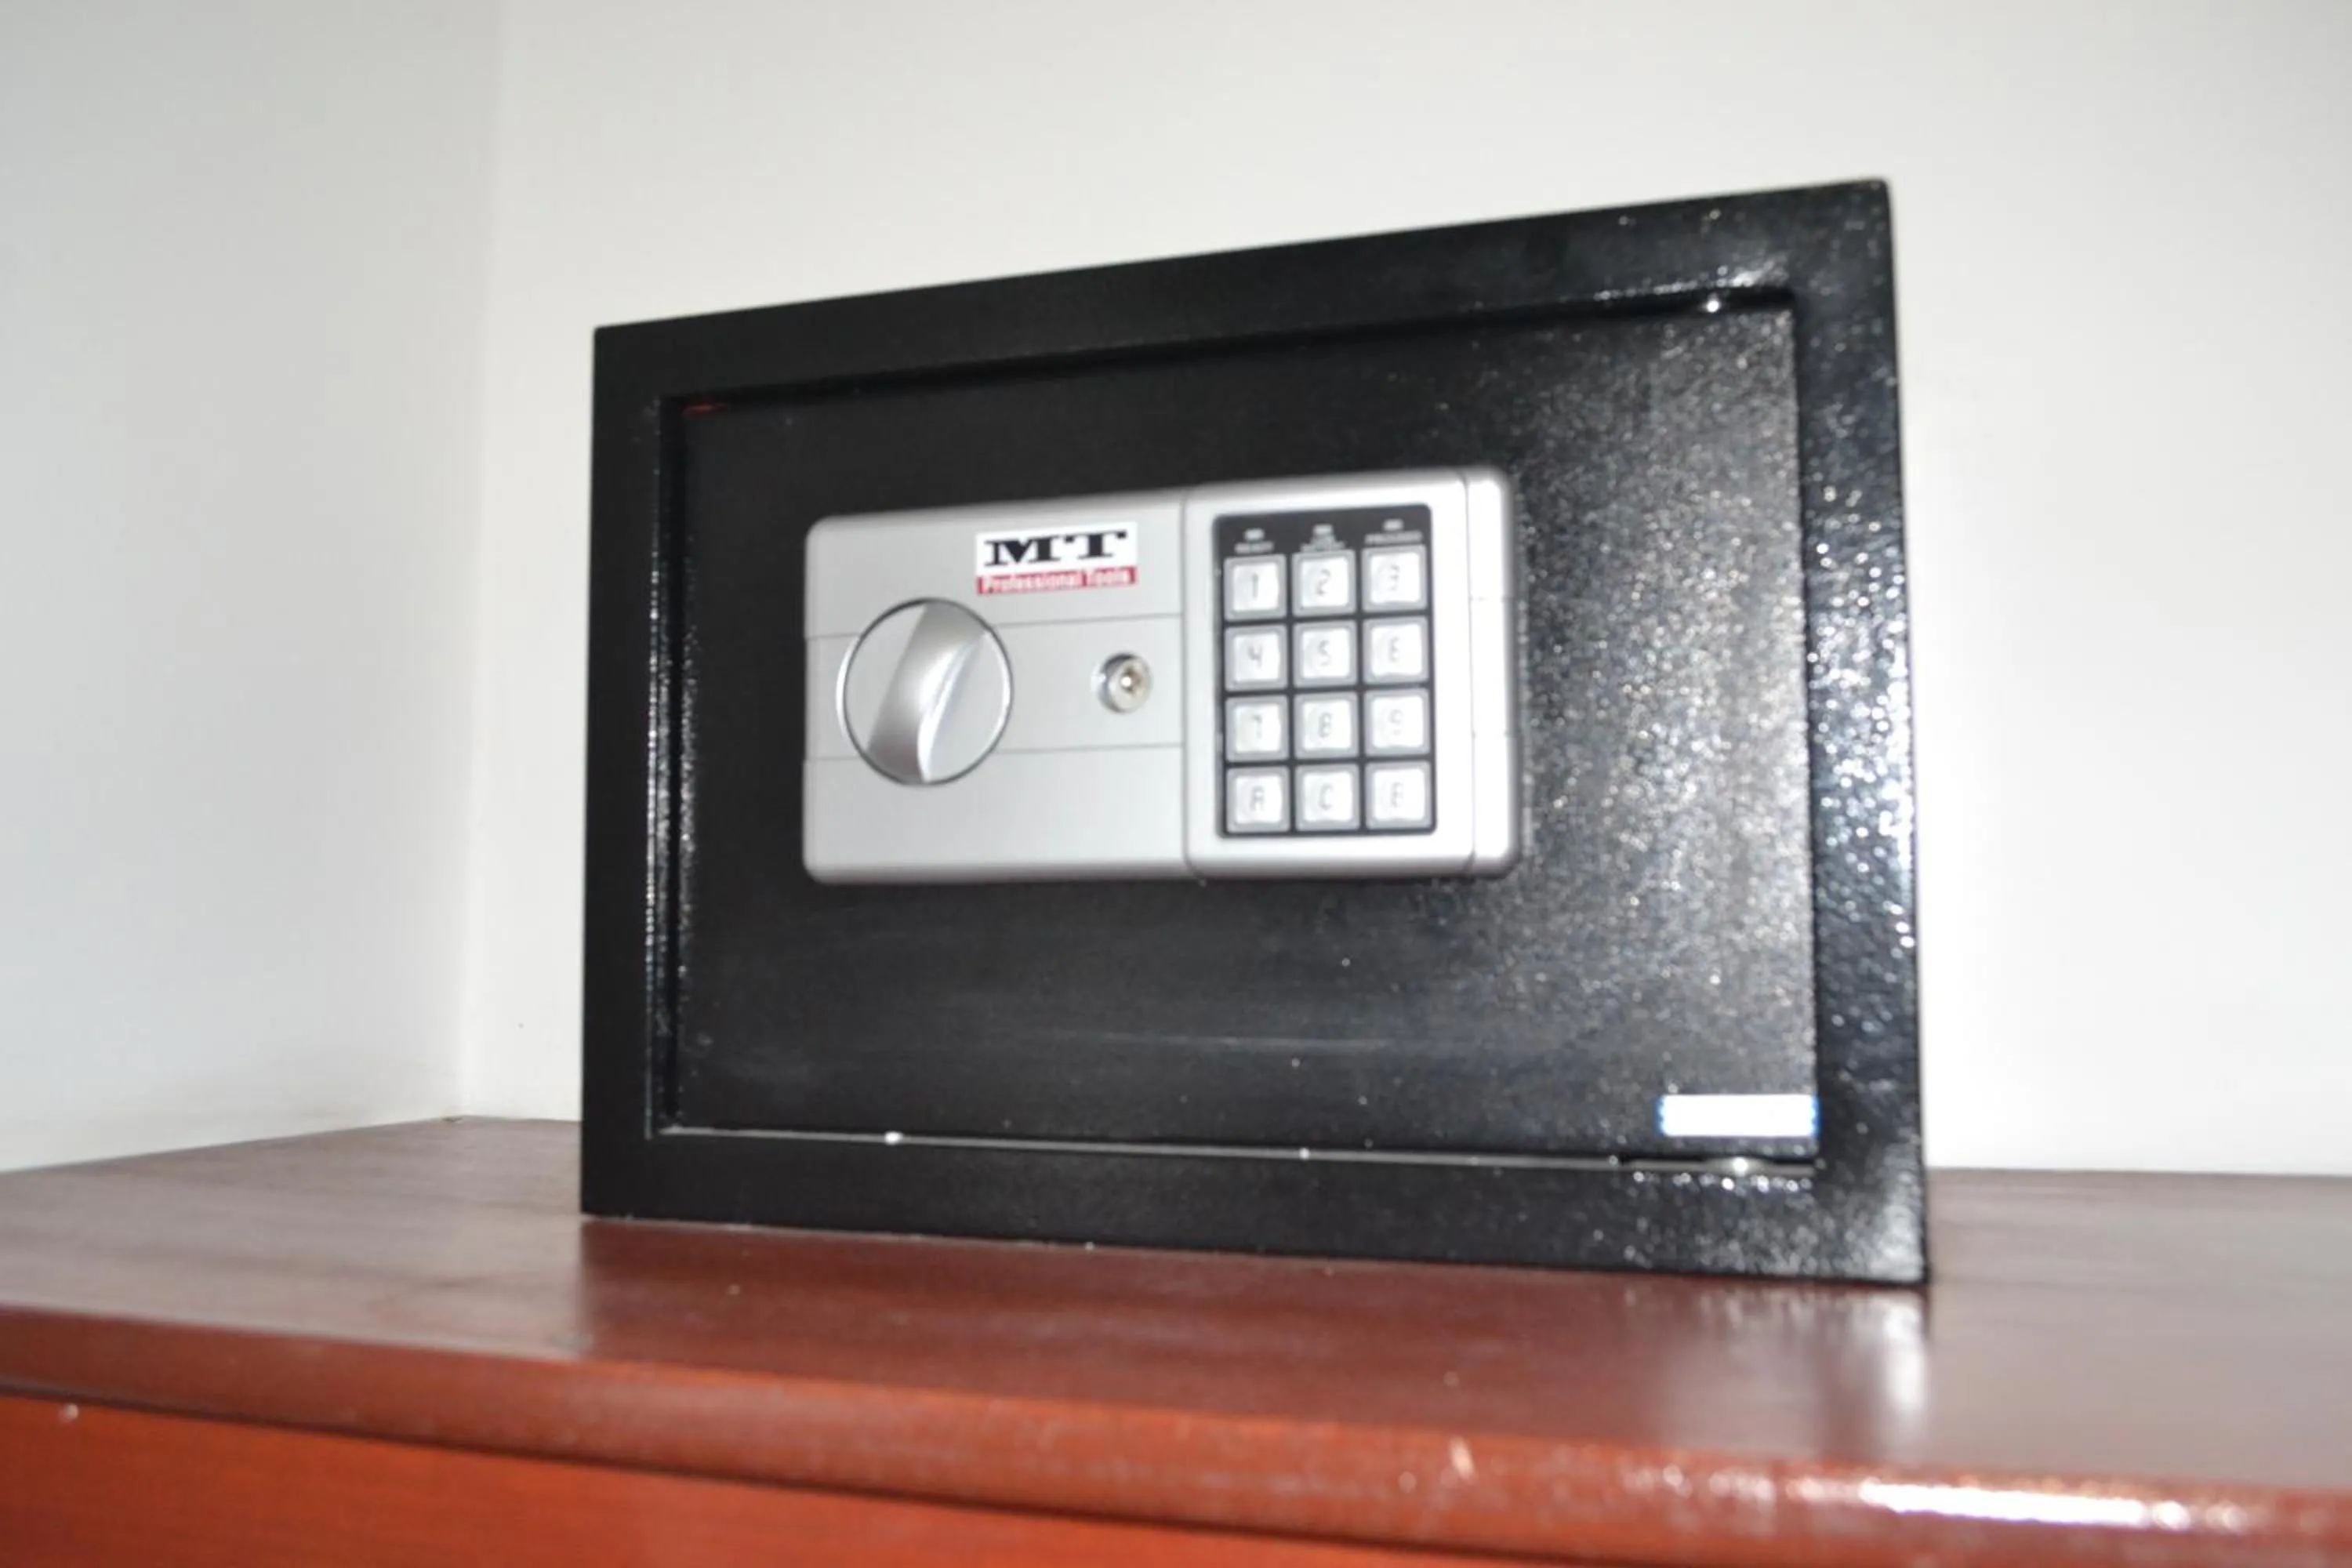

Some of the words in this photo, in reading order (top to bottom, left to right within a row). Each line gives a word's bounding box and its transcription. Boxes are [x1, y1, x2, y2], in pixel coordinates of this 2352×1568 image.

[984, 529, 1127, 567] MT
[982, 569, 1083, 593] Professional
[1088, 567, 1130, 588] Tools
[1315, 567, 1332, 597] 2
[1247, 641, 1264, 669] 4
[1317, 639, 1333, 668] 5
[1317, 711, 1334, 739] 8
[1248, 783, 1265, 812] A
